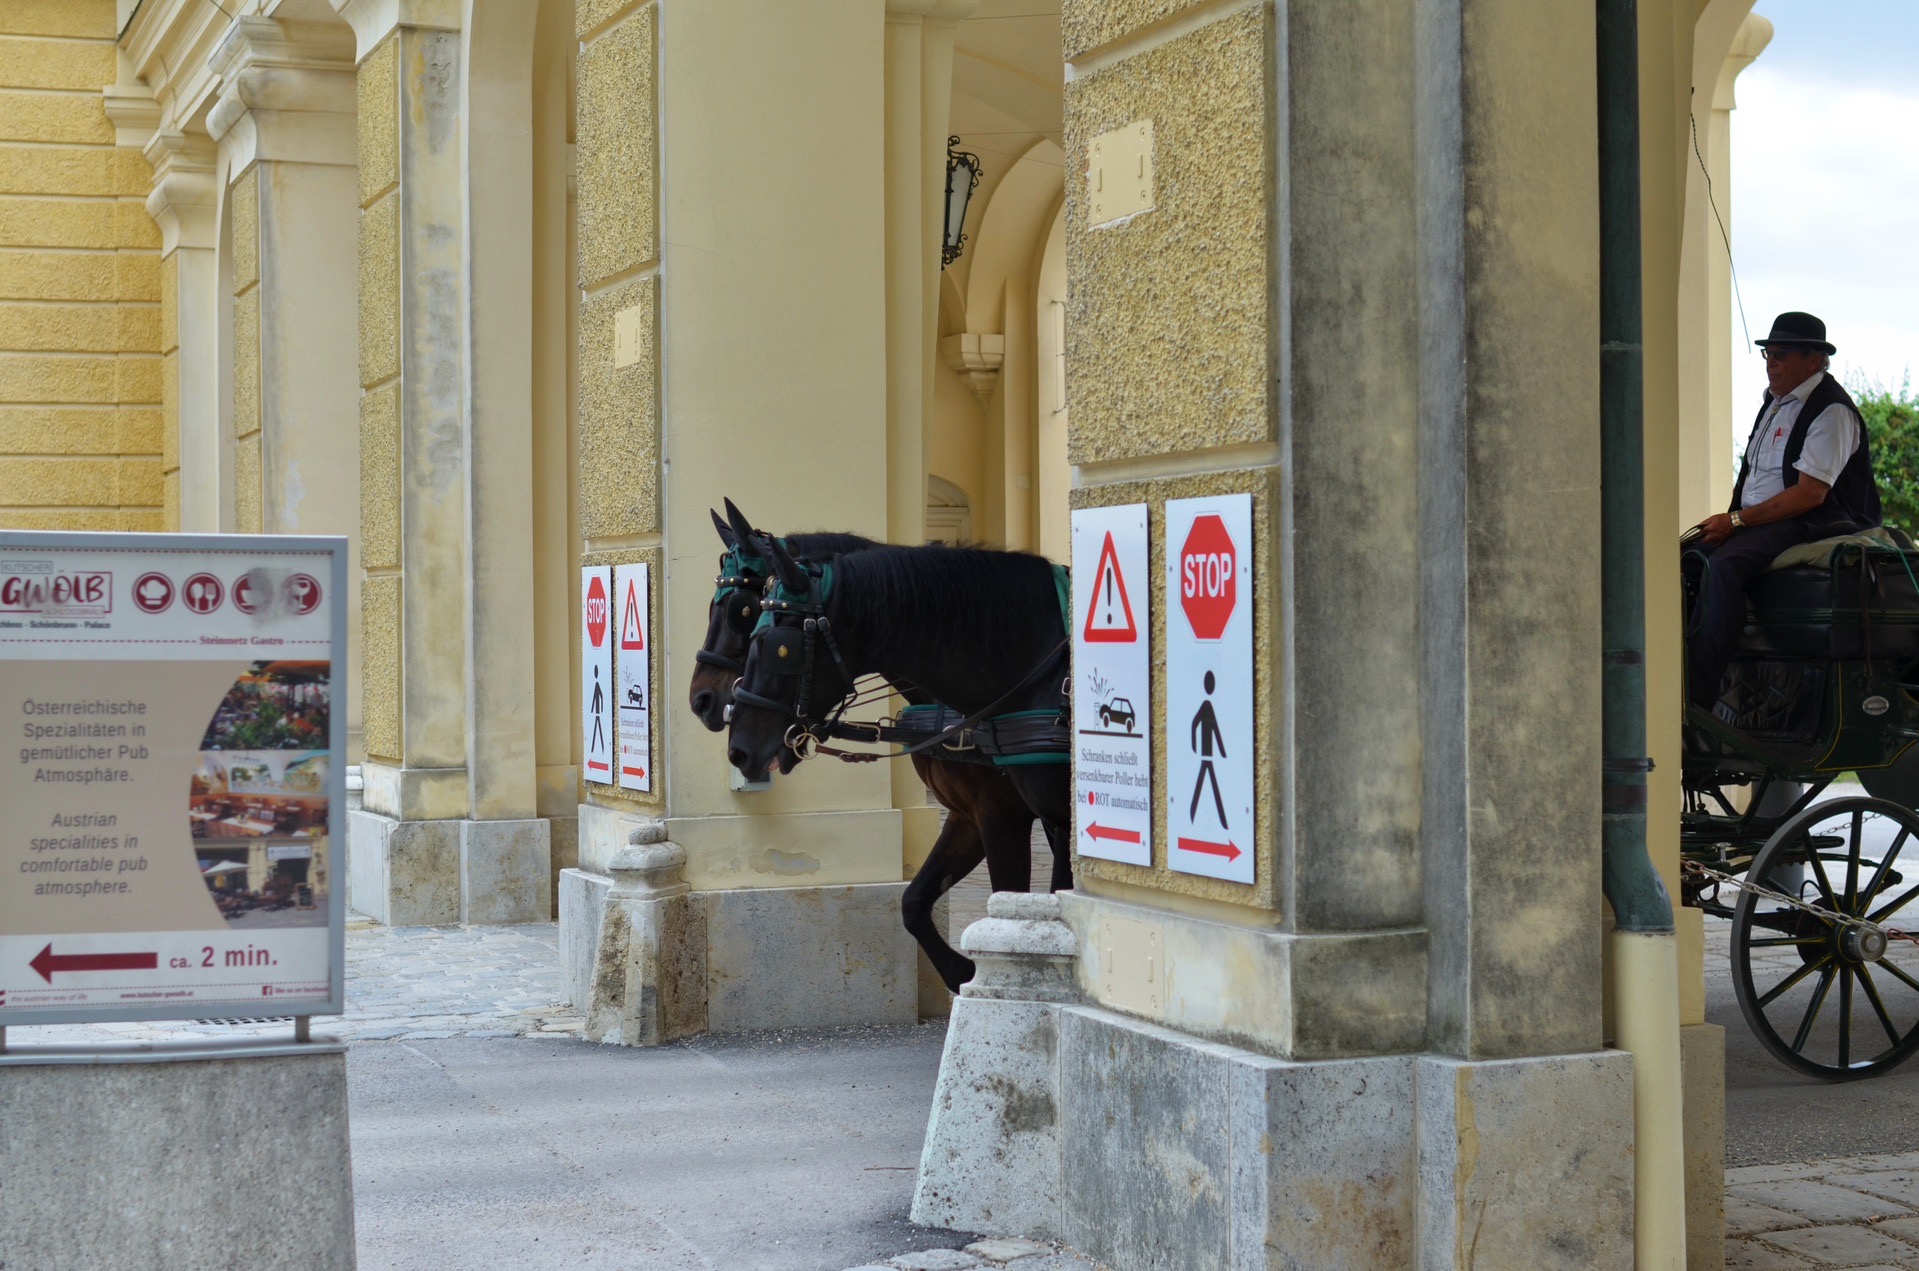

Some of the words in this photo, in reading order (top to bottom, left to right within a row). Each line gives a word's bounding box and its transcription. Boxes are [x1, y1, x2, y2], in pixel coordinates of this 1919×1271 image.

[3, 563, 52, 572] KUTSCHER
[1184, 552, 1233, 599] STOP
[588, 598, 605, 624] STOP
[0, 620, 23, 629] chloss
[30, 620, 78, 629] Schönbrunn
[85, 621, 111, 629] Palace
[199, 636, 248, 645] Steinmetz
[250, 636, 284, 645] Gastro
[22, 697, 147, 715] Österreichische
[24, 722, 127, 741] Spezialitäten
[131, 722, 146, 737] in
[20, 744, 113, 764] gemütlicher
[118, 744, 149, 759] Pub
[1081, 748, 1113, 764] Schranken
[34, 767, 134, 785] Atmosphäre.
[1115, 771, 1133, 786] Poller
[1077, 790, 1087, 804] bei
[1095, 792, 1110, 806] ROT
[1111, 796, 1148, 811] automatisch
[51, 811, 117, 827] Austrian
[30, 834, 119, 853] specialities
[123, 833, 138, 848] in
[20, 856, 114, 873] comfortable
[117, 856, 148, 874] pub
[35, 879, 132, 897] atmosphere.
[169, 957, 192, 968] ca.
[201, 946, 215, 967] 2
[225, 944, 278, 967] min.
